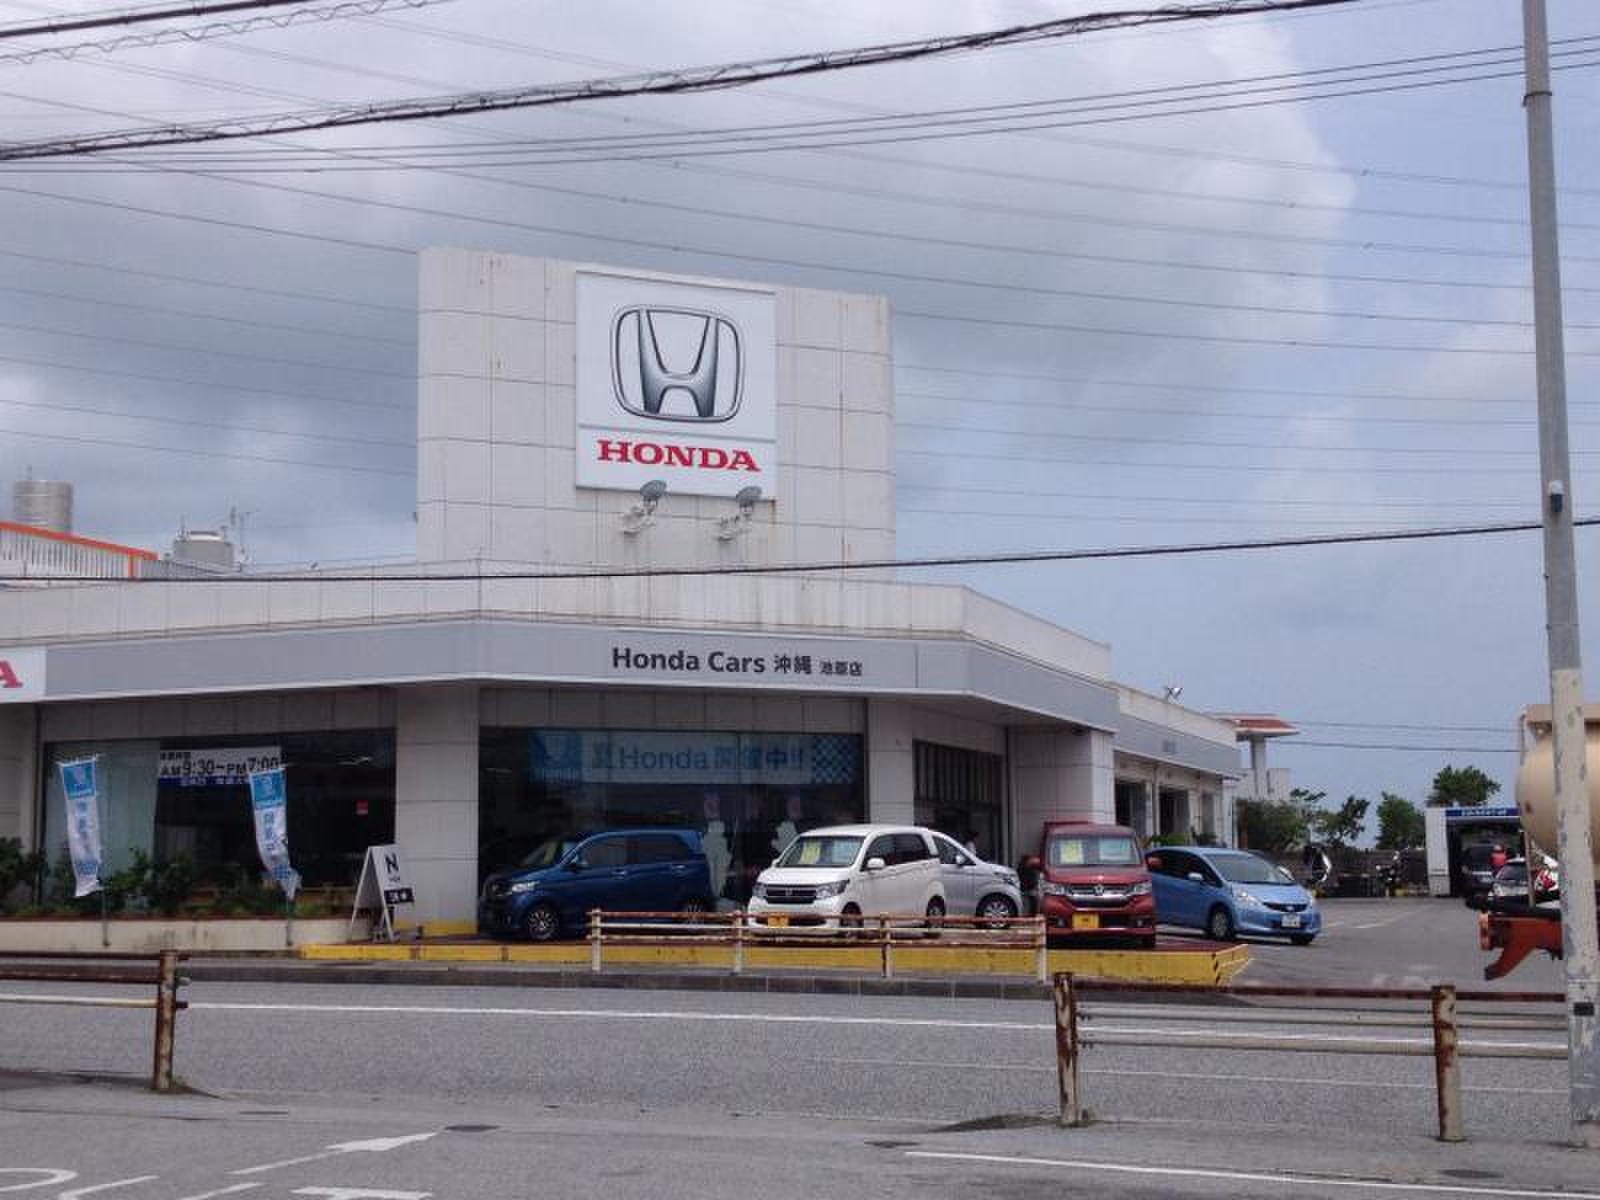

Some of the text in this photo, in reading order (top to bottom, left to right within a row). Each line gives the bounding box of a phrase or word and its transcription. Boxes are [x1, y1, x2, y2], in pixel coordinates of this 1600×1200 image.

[597, 440, 761, 473] HONDA
[612, 647, 700, 672] Honda
[708, 651, 765, 673] Cars
[774, 653, 811, 675] 沖縄
[619, 745, 706, 770] Honda
[385, 853, 399, 874] N
